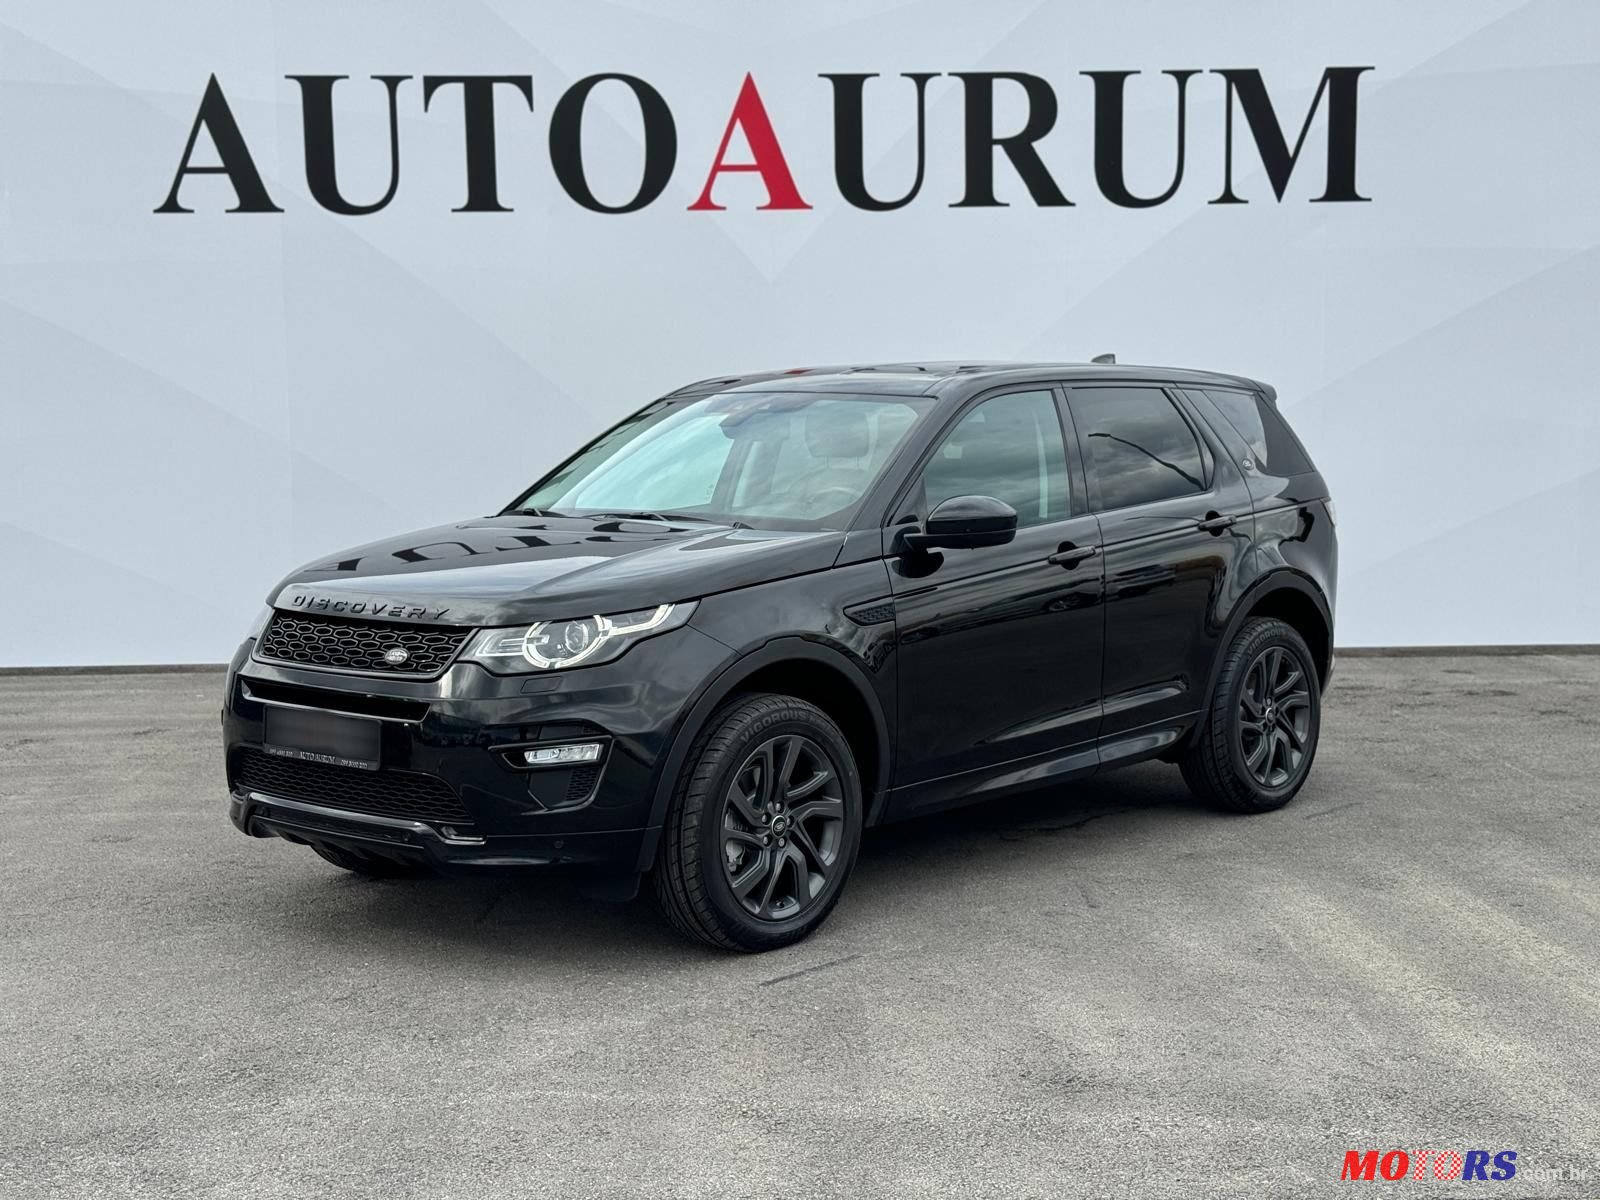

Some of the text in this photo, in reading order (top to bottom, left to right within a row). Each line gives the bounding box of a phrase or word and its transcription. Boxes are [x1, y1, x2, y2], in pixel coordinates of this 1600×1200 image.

[153, 66, 1375, 215] AUTOAURUM
[291, 594, 450, 620] DISCOVERY
[740, 709, 808, 743] VIGOROUS
